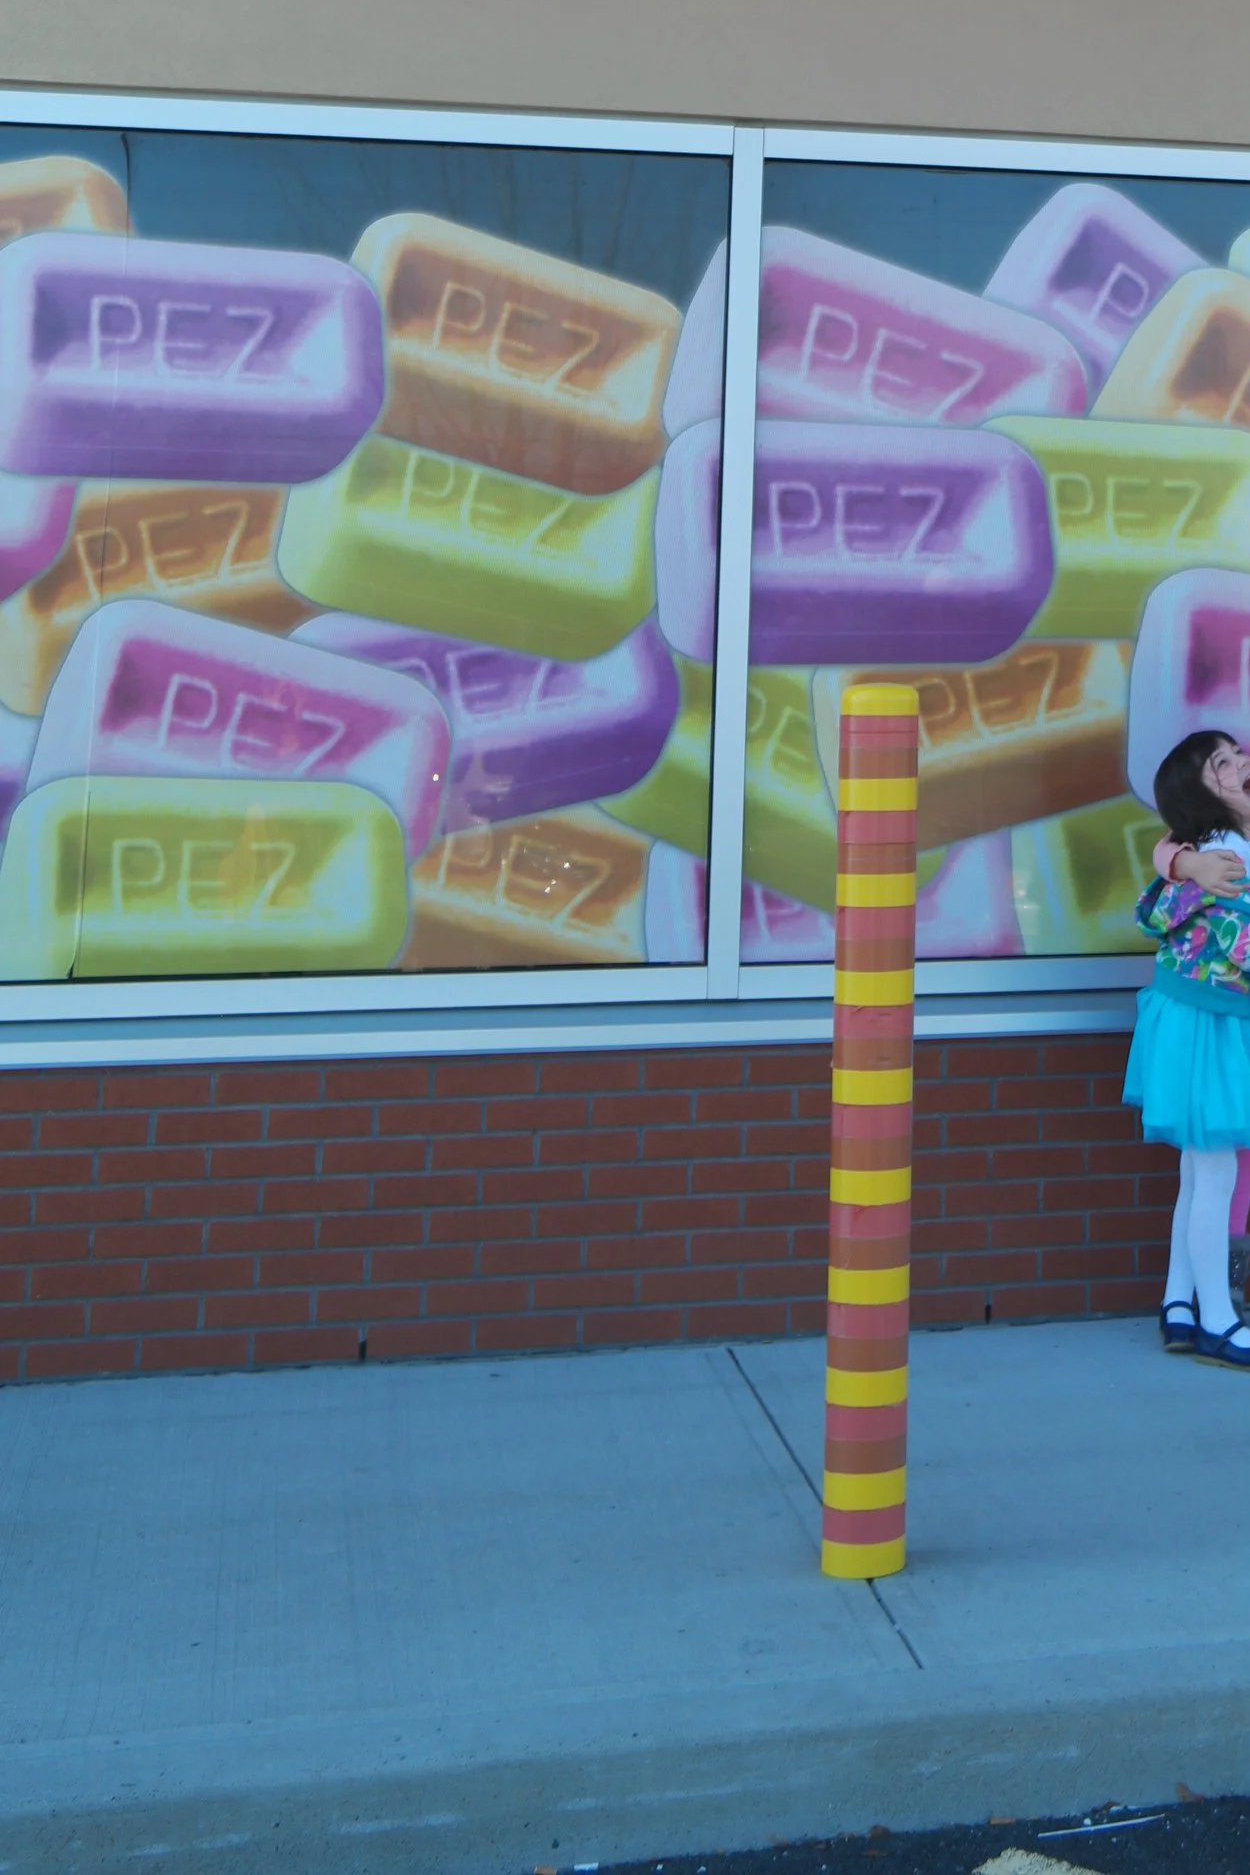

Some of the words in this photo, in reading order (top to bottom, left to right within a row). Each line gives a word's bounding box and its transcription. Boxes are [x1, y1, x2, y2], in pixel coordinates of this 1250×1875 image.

[89, 293, 305, 383] PEZ
[434, 280, 618, 409] PEZ
[800, 302, 985, 421] PEZ
[75, 500, 275, 605] PEZ
[768, 480, 975, 561] PEZ
[157, 674, 346, 775] PEZ
[112, 838, 320, 919] PEZ
